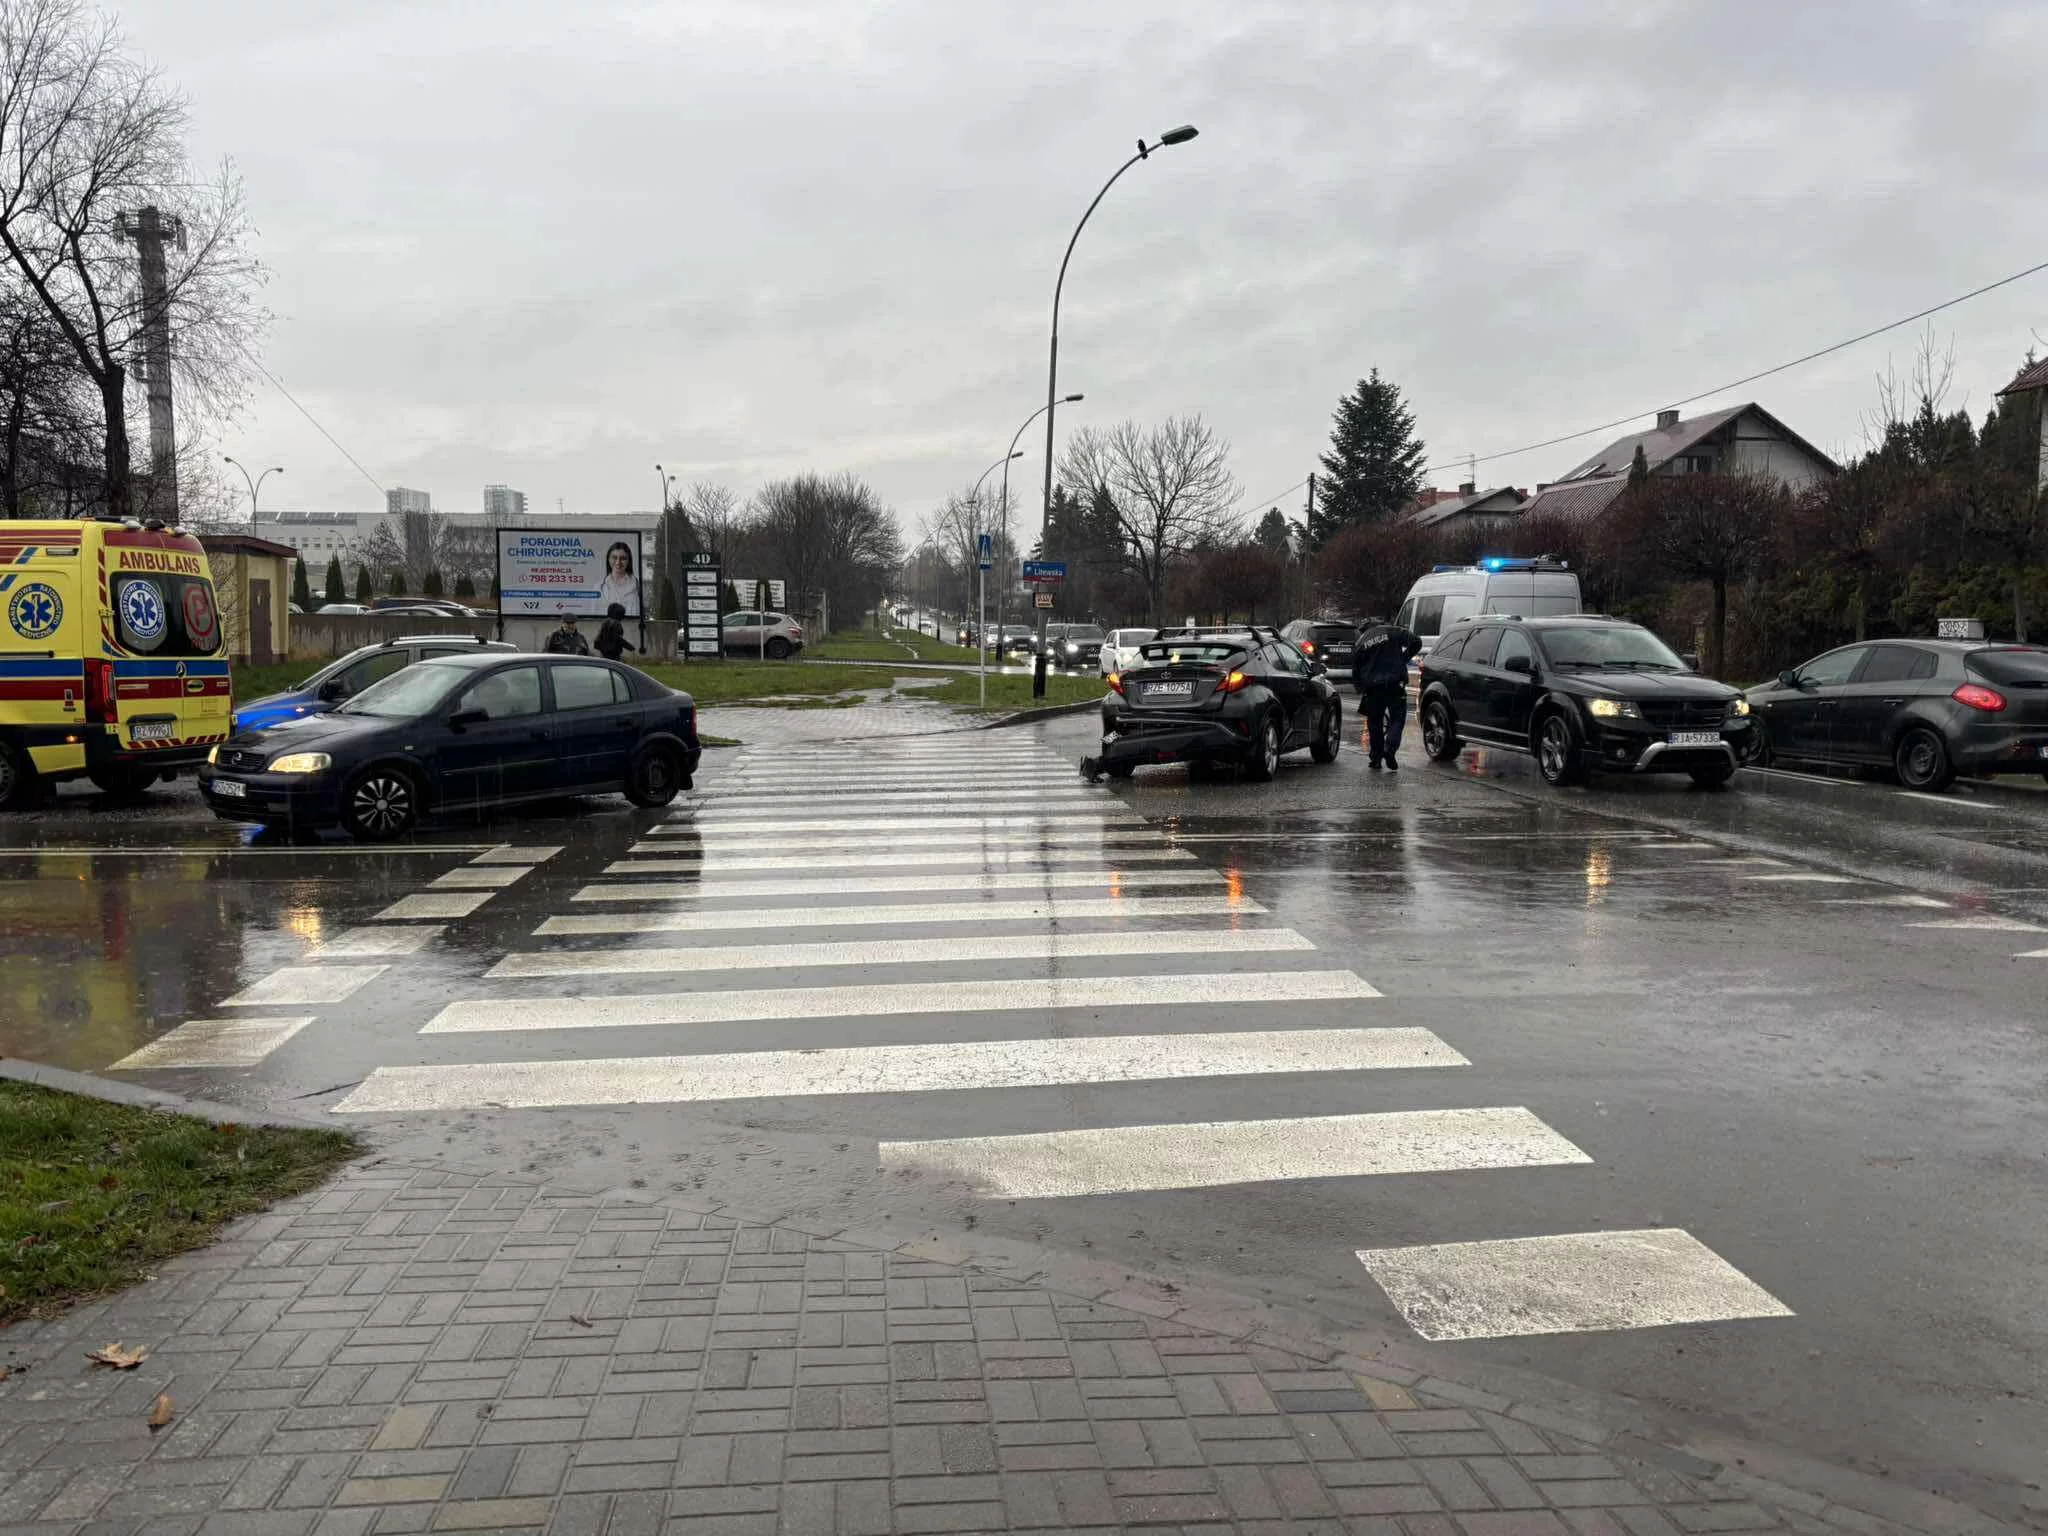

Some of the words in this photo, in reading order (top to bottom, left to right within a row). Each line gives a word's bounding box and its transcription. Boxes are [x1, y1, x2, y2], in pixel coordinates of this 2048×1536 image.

[520, 537, 581, 547] PORADNIA
[507, 547, 595, 558] CHIRURGICZNA
[120, 551, 200, 573] AMBULANS
